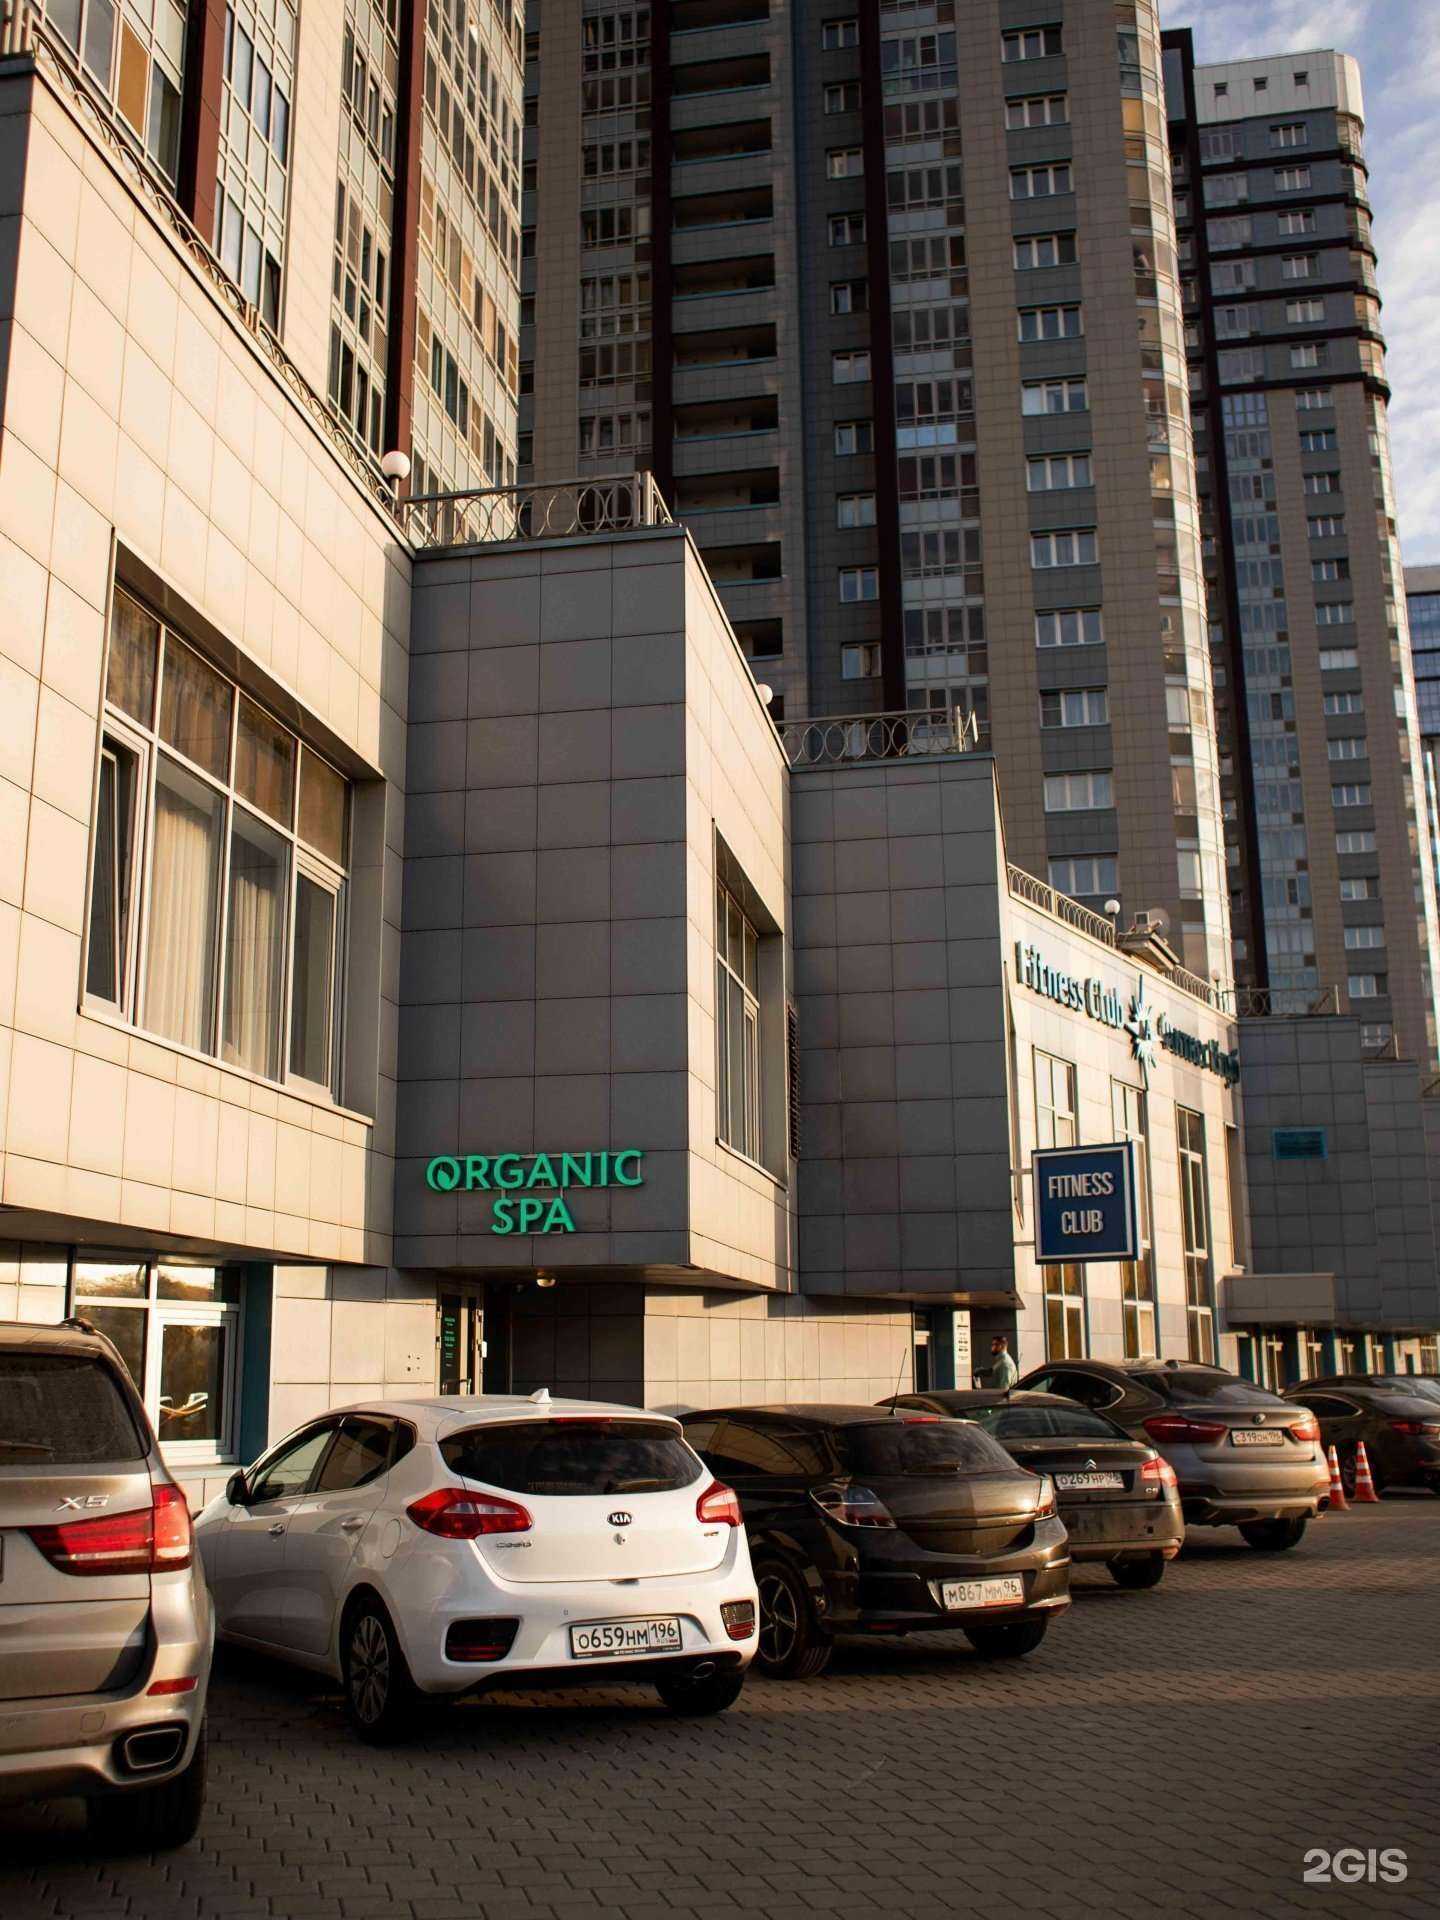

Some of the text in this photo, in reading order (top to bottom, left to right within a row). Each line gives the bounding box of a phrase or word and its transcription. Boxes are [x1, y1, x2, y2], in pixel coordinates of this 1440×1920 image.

[1014, 941, 1125, 1029] Fitness Club
[426, 1150, 645, 1192] ORGANIC
[1048, 1171, 1115, 1199] FITNESS
[490, 1196, 576, 1235] SPA
[1061, 1209, 1104, 1235] CLUB
[54, 1494, 110, 1512] X5
[1003, 1580, 1018, 1593] 96
[578, 1622, 676, 1649] О659НМ 196
